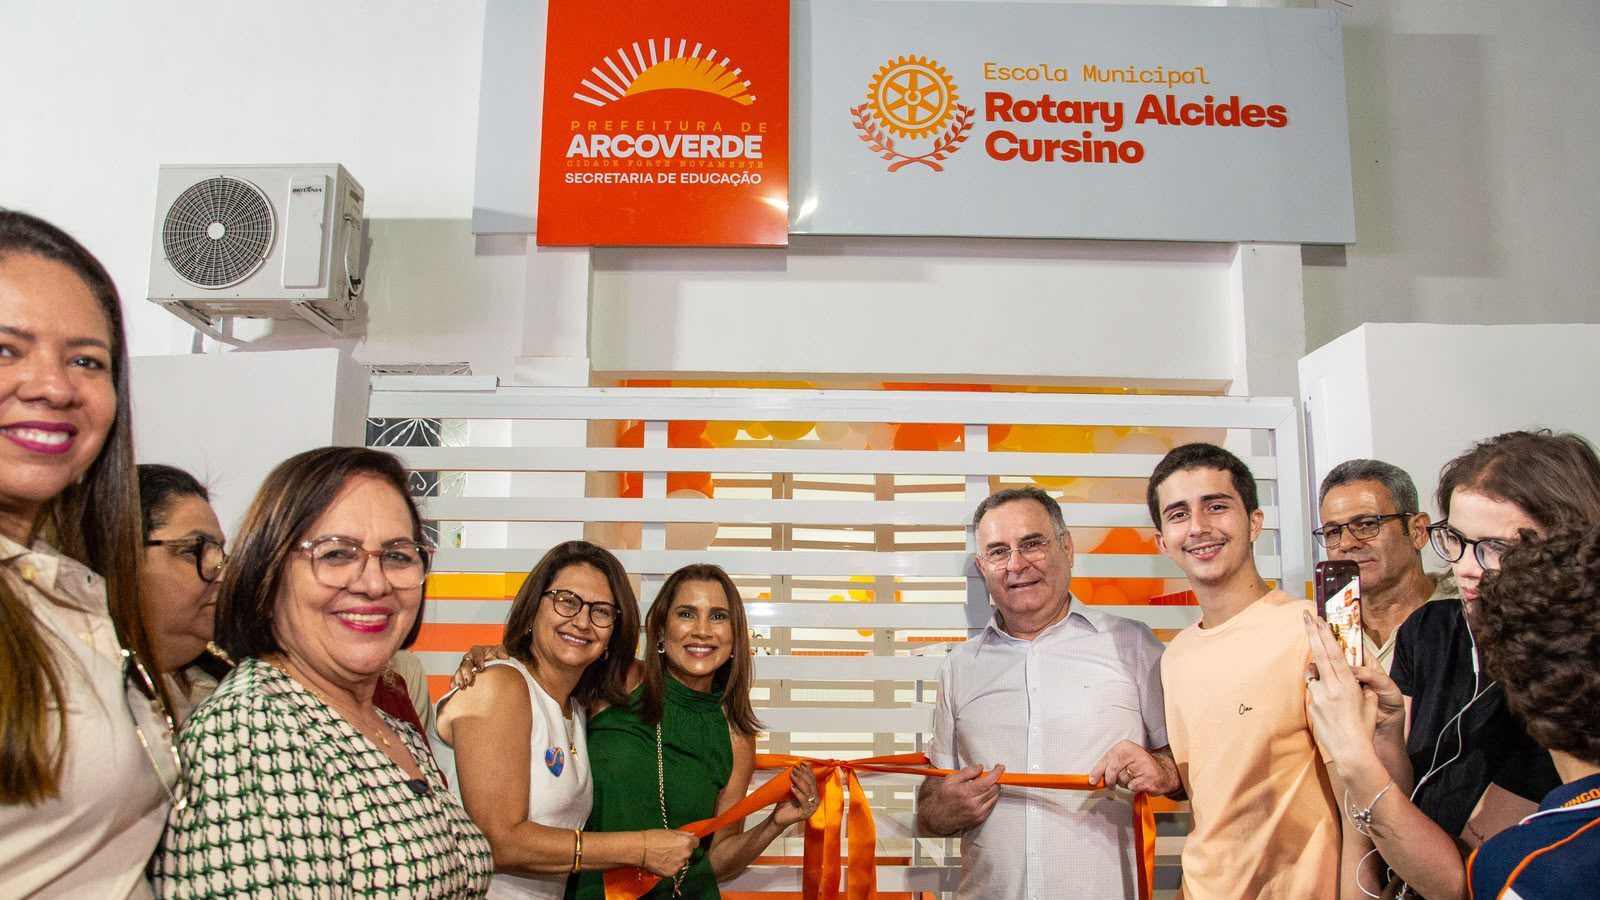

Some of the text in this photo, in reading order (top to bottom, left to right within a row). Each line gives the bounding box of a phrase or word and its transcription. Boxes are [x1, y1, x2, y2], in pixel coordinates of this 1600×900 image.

[983, 62, 1209, 88] Escola Municipal
[985, 91, 1288, 132] Rotary Alcides
[571, 120, 768, 133] PREFEITURA DE
[566, 134, 763, 159] ARCOVERDE
[985, 130, 1145, 164] Cursino
[566, 159, 764, 169] CIDADE FORTE NOVAMENTE
[565, 171, 762, 187] SECRETARIA DE EDUCAÇÃO
